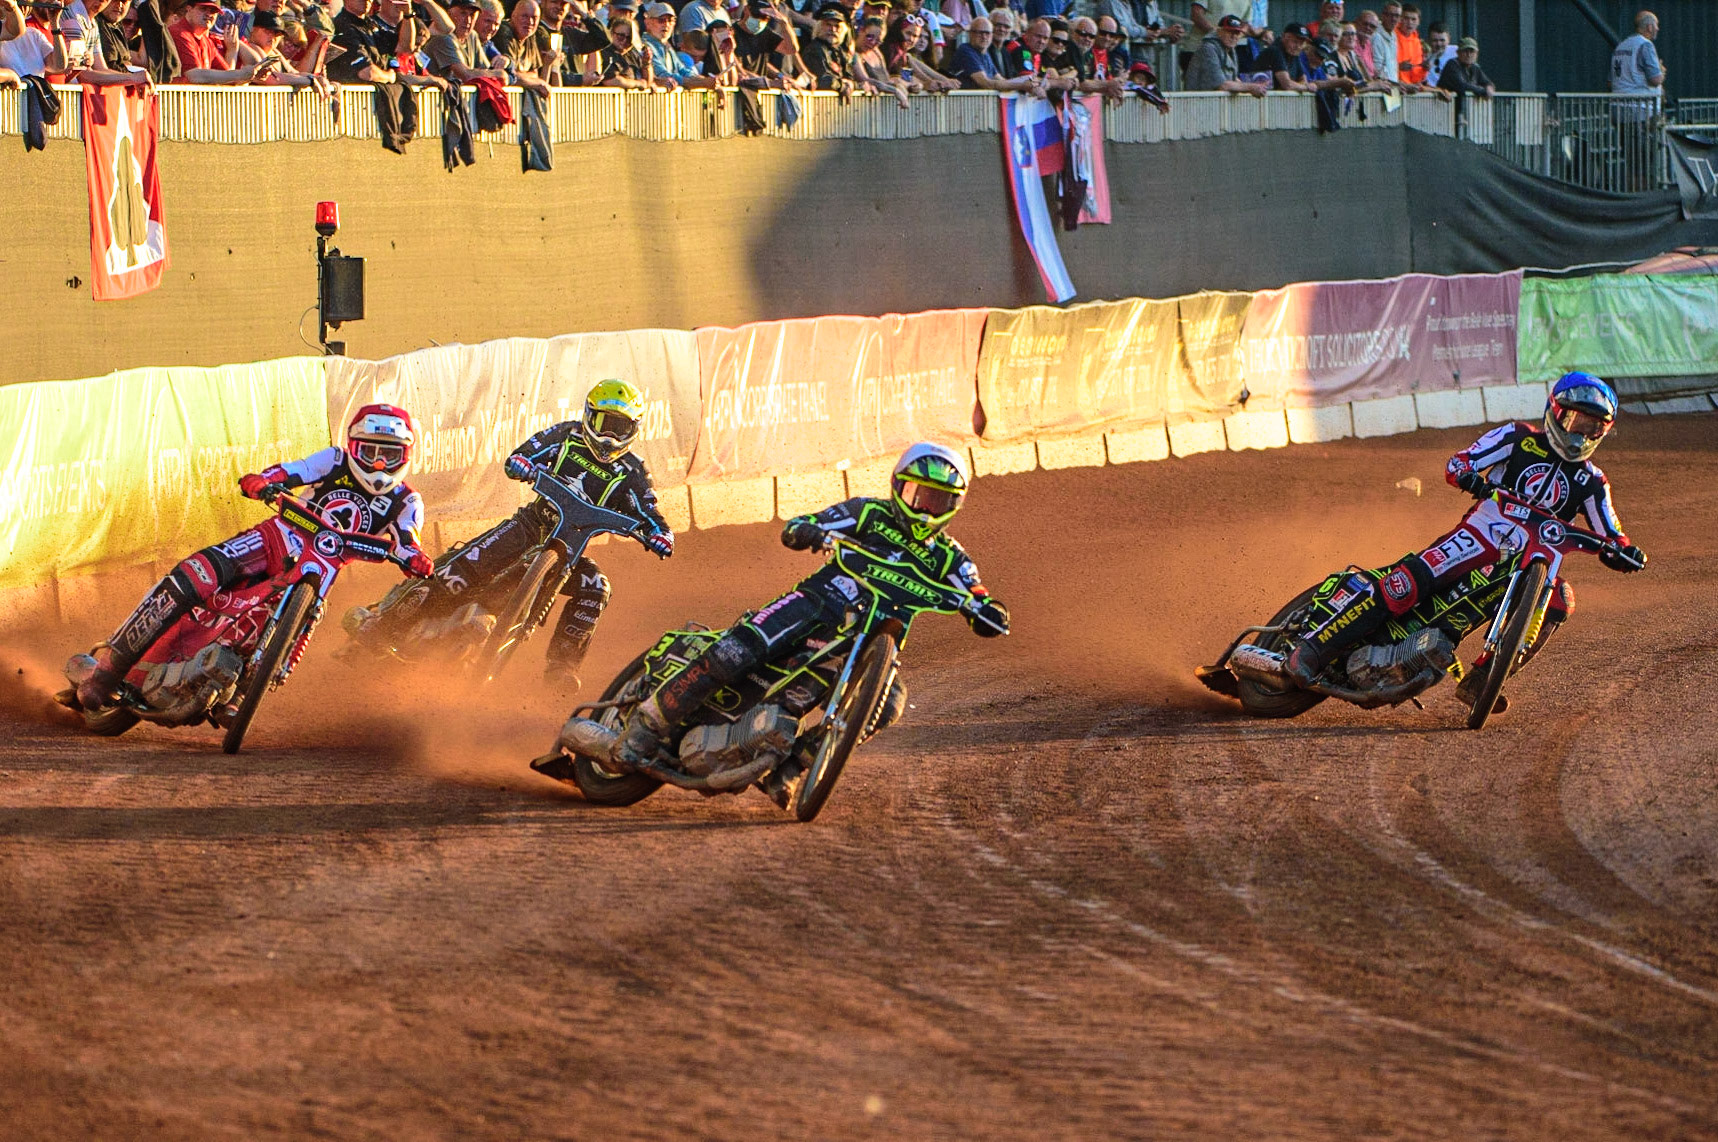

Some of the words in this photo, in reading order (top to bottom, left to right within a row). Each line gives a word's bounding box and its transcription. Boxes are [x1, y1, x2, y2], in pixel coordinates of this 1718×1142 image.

[1525, 466, 1546, 478] BELLE
[327, 491, 351, 501] BELLE
[361, 510, 370, 530] ACES
[1437, 530, 1475, 559] FTS
[1317, 597, 1376, 643] MYNEFIT
